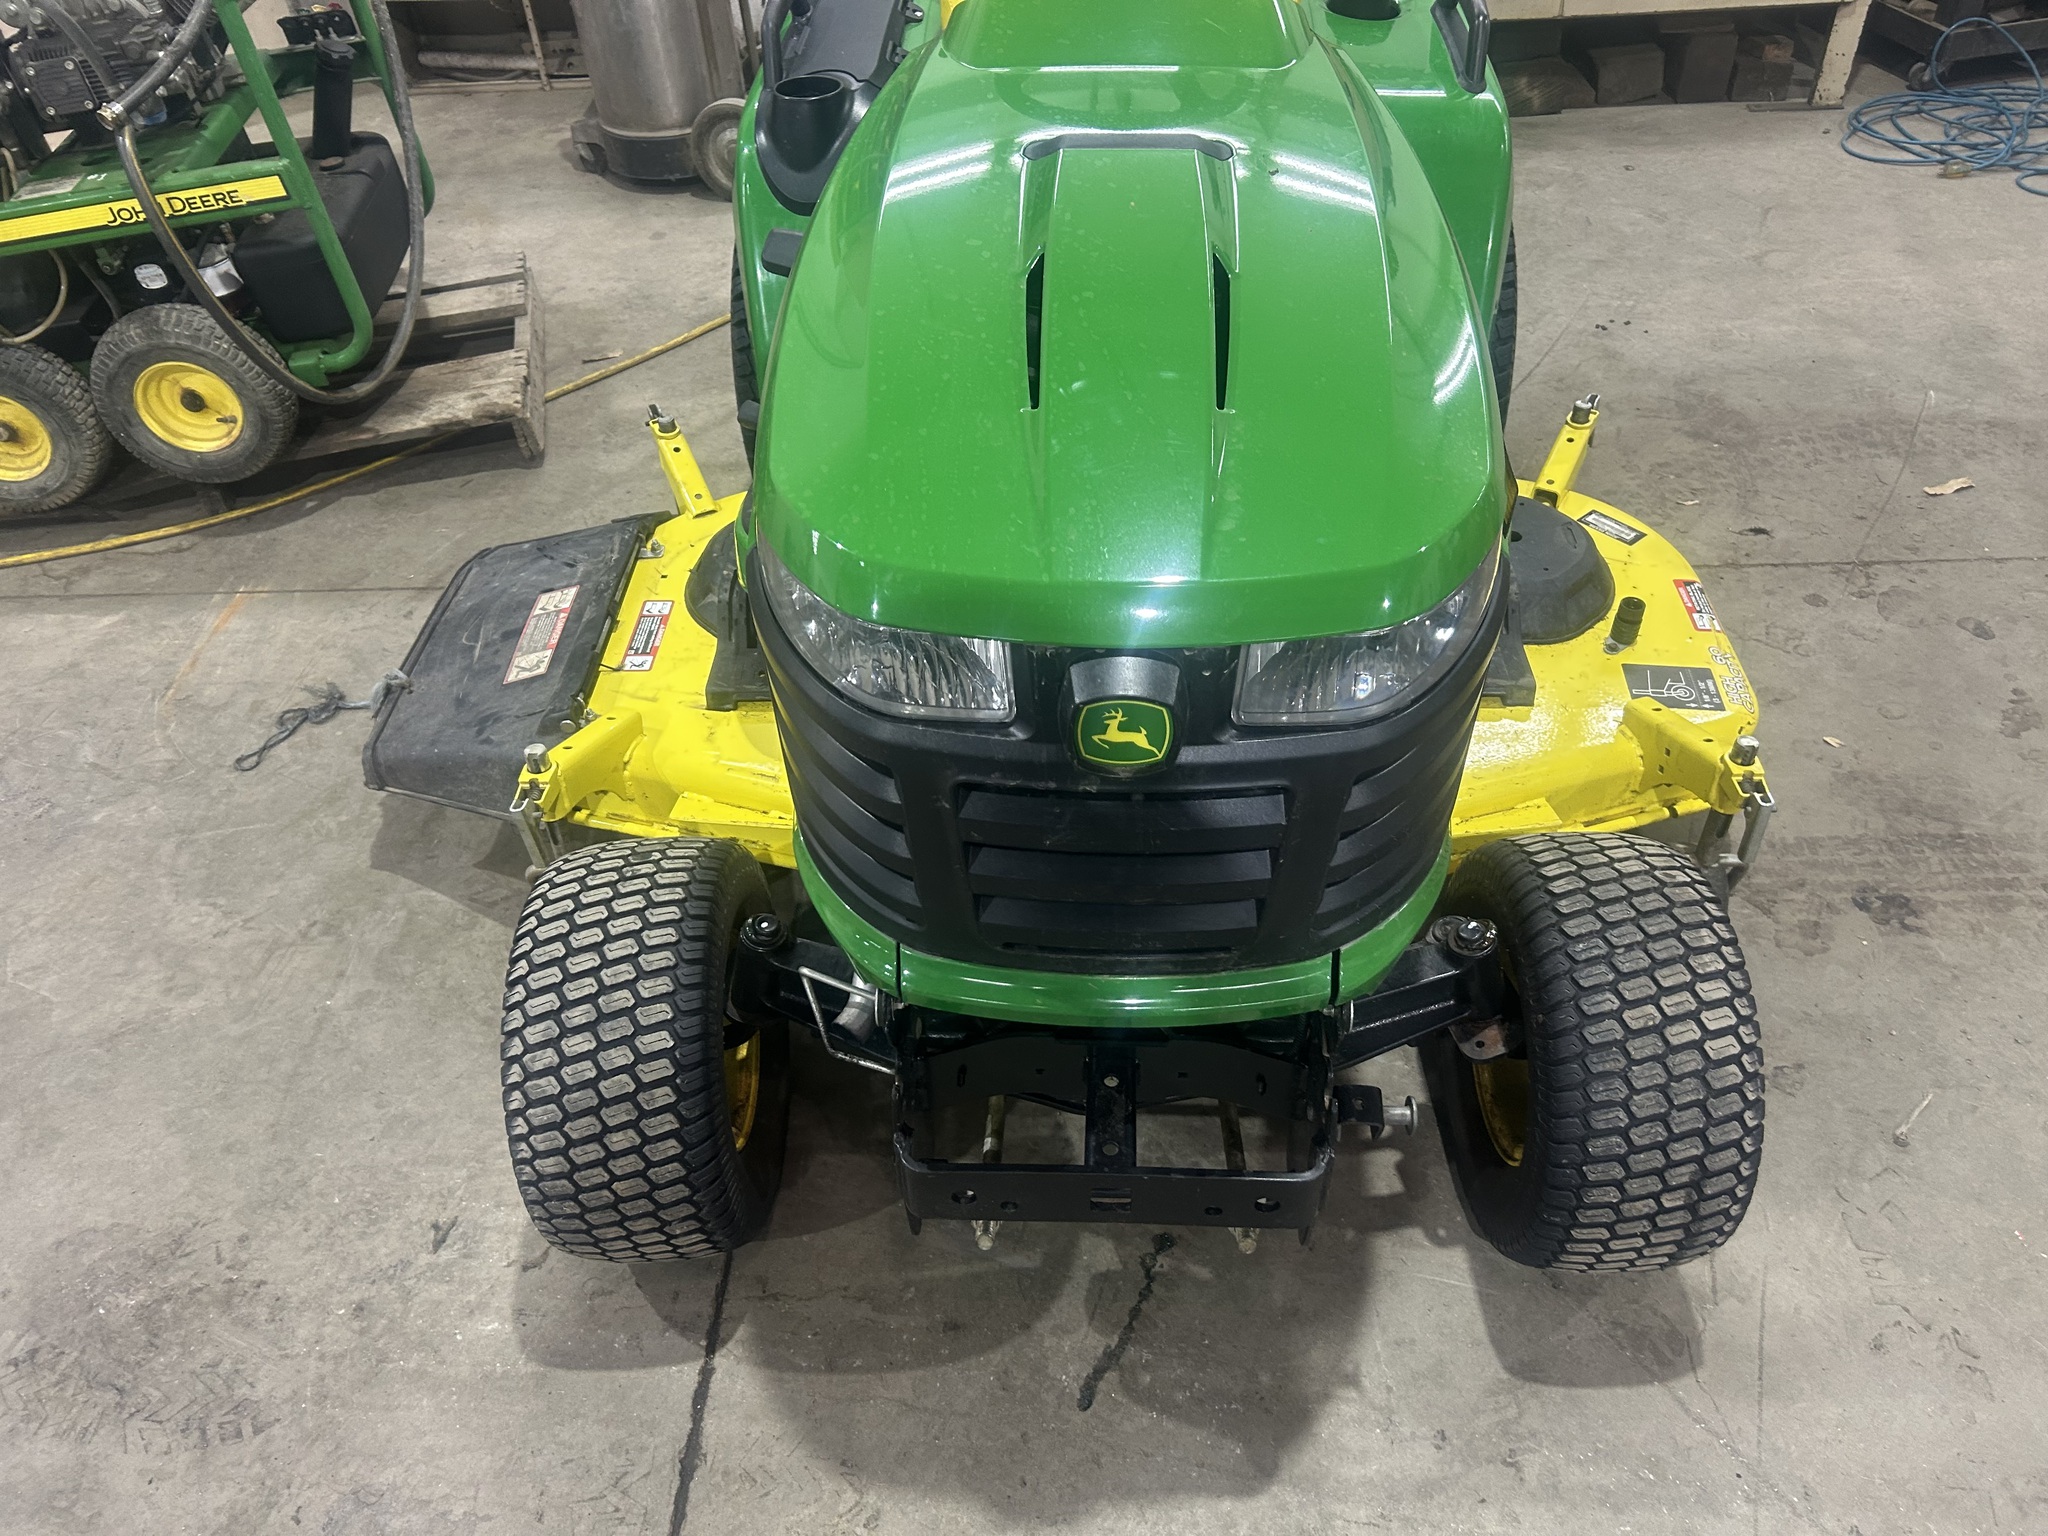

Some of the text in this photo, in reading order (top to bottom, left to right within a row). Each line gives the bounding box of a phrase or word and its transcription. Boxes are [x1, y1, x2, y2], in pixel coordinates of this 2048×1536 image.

[166, 189, 244, 214] DEERE
[1708, 646, 1744, 706] HIGH 60
